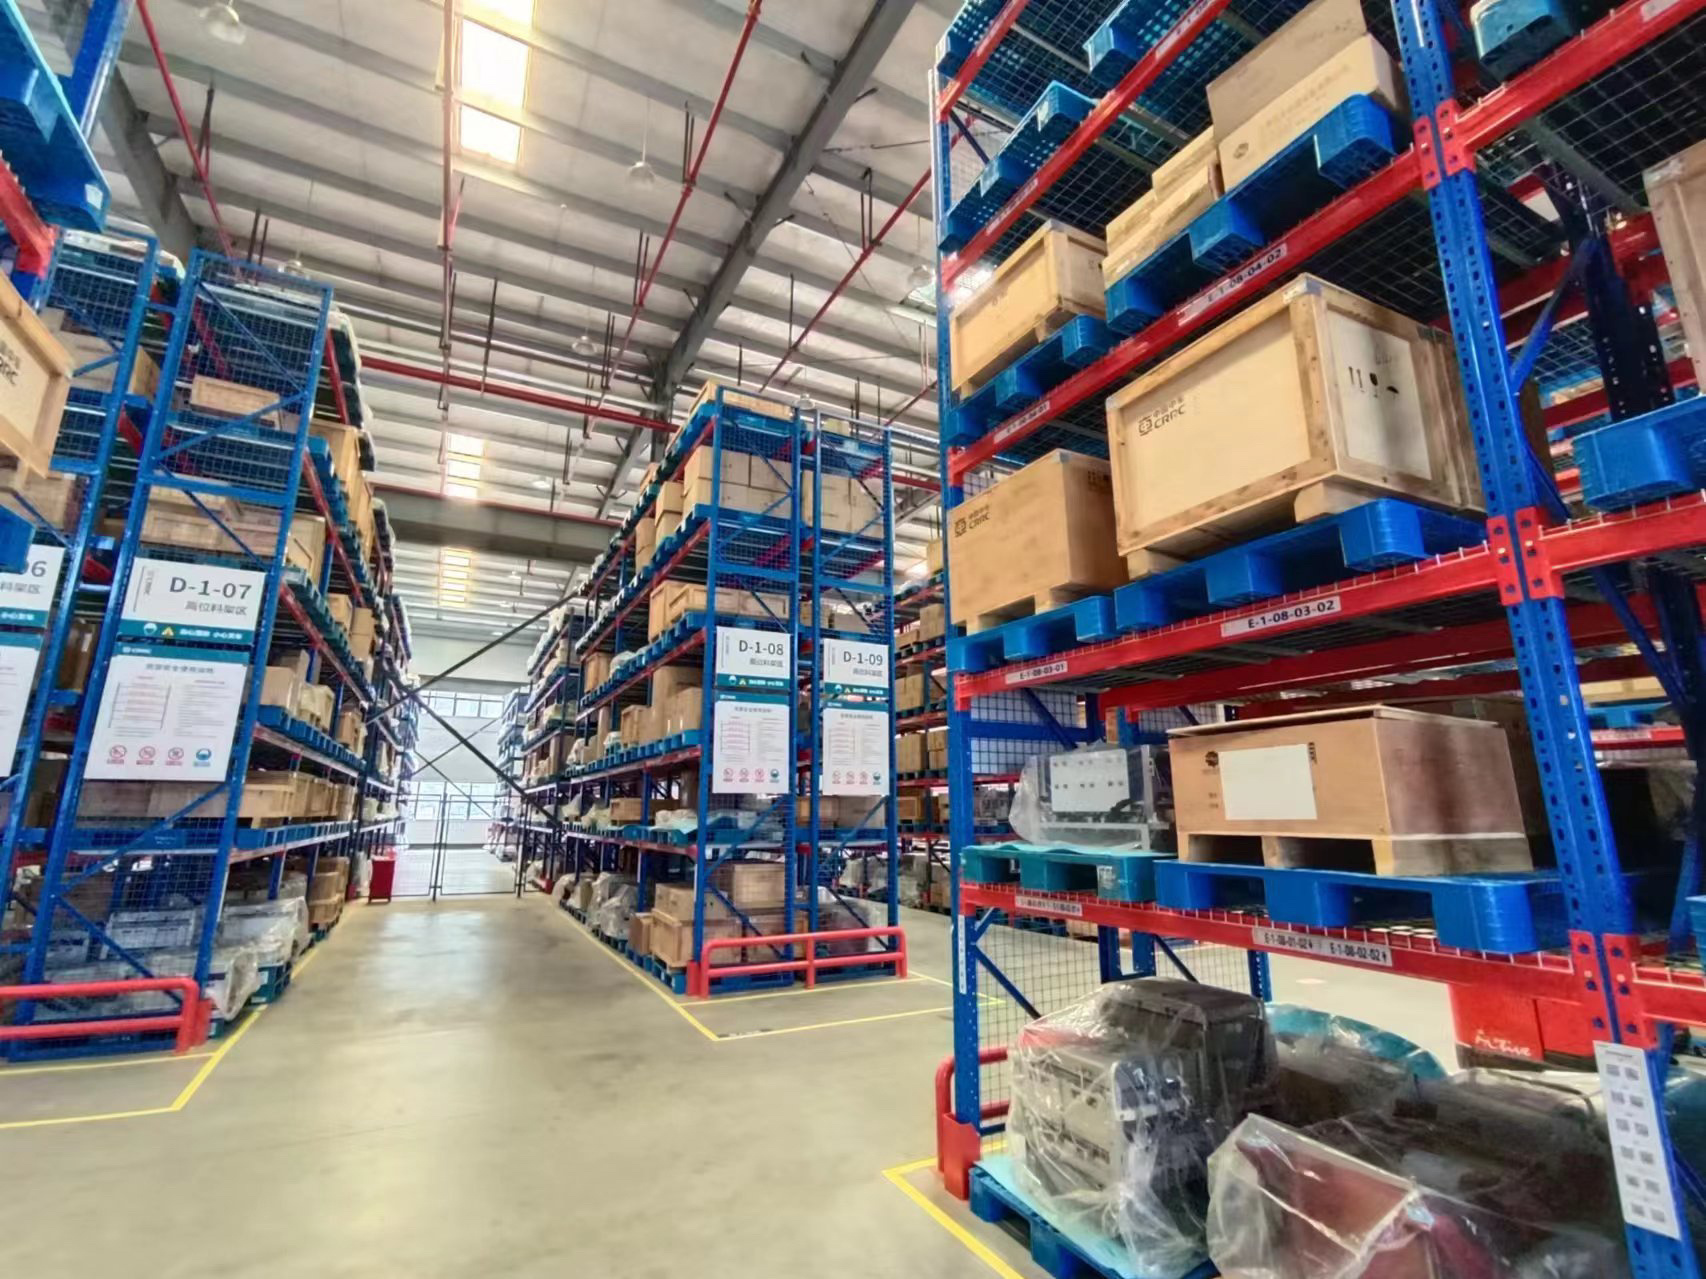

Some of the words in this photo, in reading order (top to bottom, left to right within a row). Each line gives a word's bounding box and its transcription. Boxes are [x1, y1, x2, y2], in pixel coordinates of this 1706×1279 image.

[1154, 404, 1185, 428] CRRC
[169, 576, 252, 600] D-1-07
[1247, 600, 1336, 629] E-1-08-03-02
[739, 640, 784, 656] D-1-08
[843, 651, 884, 666] D-1-09
